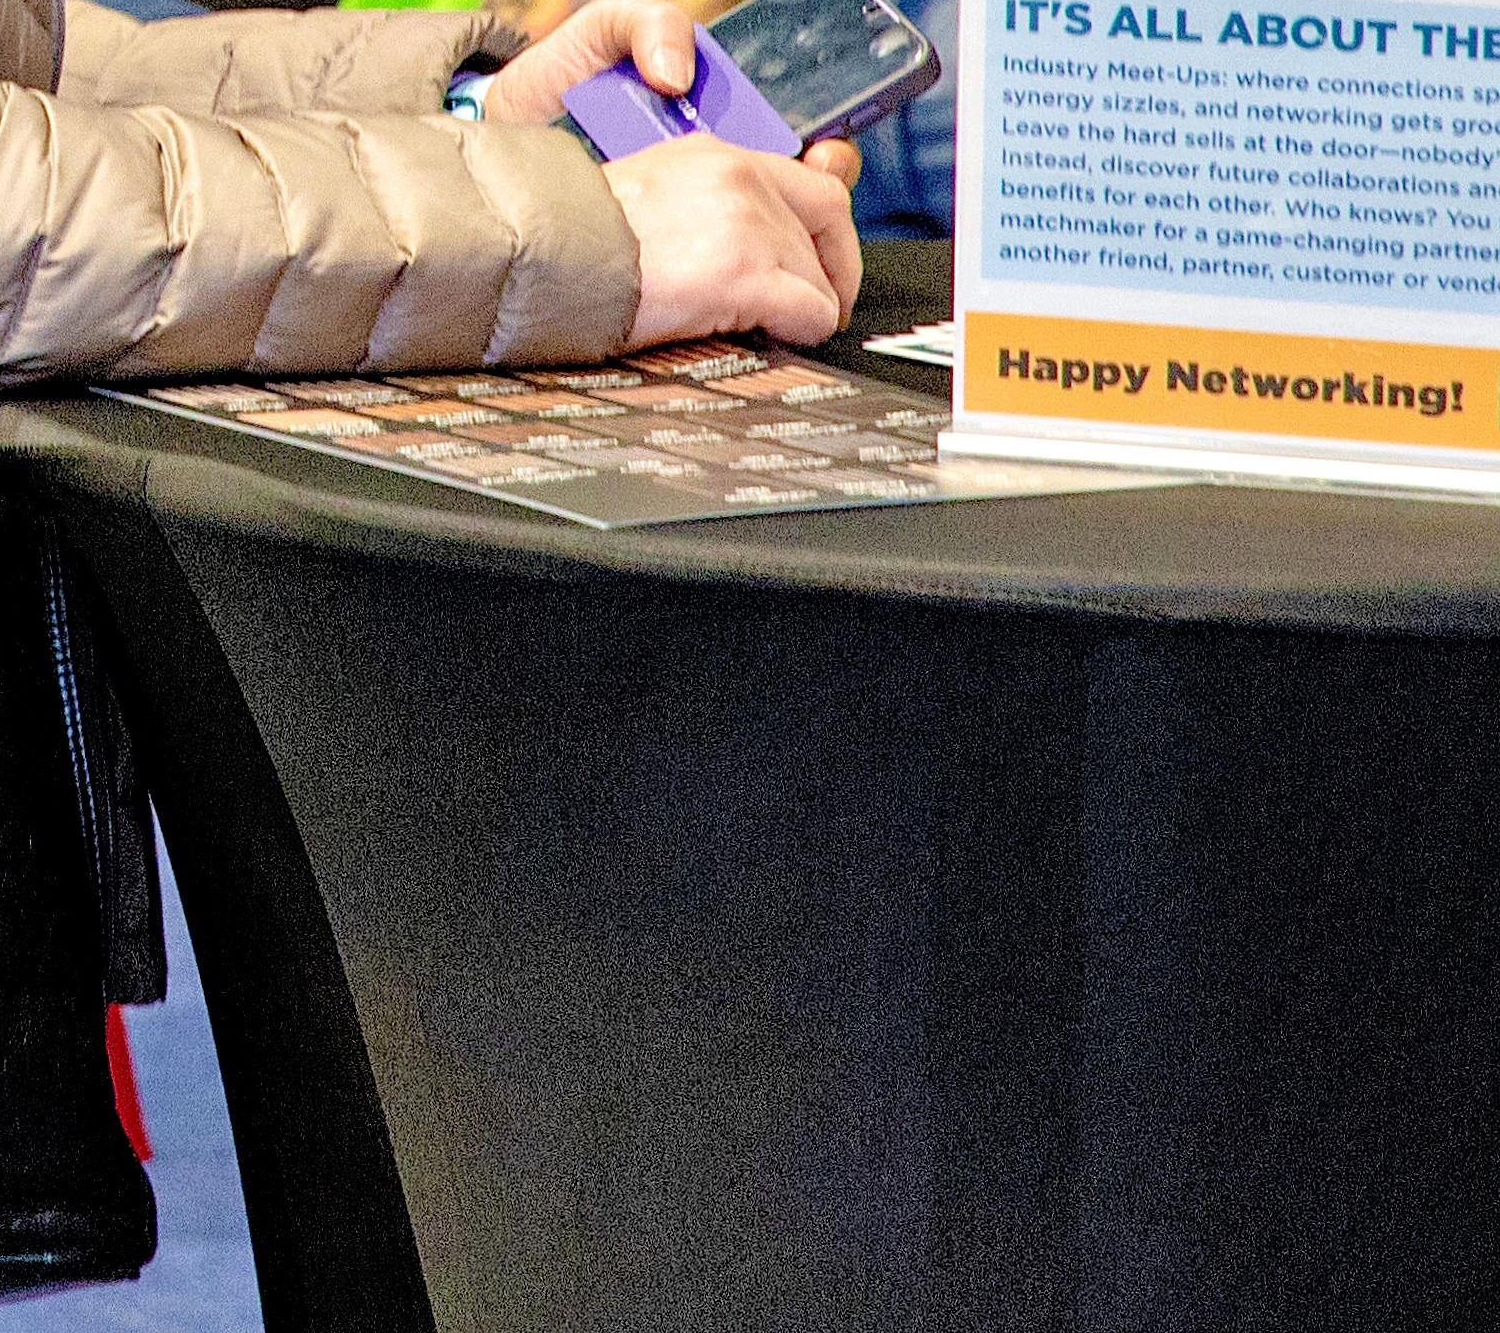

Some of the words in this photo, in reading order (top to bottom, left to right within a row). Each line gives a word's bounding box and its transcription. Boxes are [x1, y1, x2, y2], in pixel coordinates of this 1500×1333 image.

[1107, 5, 1203, 43] ALL
[1217, 11, 1397, 54] ABOUT
[1412, 21, 1500, 61] THE
[1003, 54, 1098, 81] Industry
[1107, 60, 1228, 90] Meet-Ups:
[1236, 70, 1309, 91] where
[1317, 76, 1465, 102] connections
[1002, 88, 1094, 112] synergy
[1102, 93, 1186, 118] sizzles,
[1194, 100, 1239, 118] and
[1247, 102, 1383, 131] networking
[1391, 112, 1443, 132] gets
[1002, 116, 1070, 139] Leave
[1078, 122, 1115, 142] the
[1123, 124, 1176, 147] hard
[1185, 130, 1235, 151] sells
[1243, 135, 1266, 152] at
[1275, 135, 1313, 155] the
[1002, 147, 1093, 174] Instead,
[1101, 155, 1200, 179] discover
[1209, 161, 1279, 184] future
[1288, 168, 1460, 197] collaborations
[1468, 183, 1500, 199] an
[1000, 178, 1095, 204] benefits
[1104, 185, 1137, 205] for
[1144, 190, 1200, 211] each
[1208, 195, 1276, 217] other.
[1285, 197, 1341, 220] Who
[1349, 202, 1438, 227] knows?
[1447, 208, 1491, 231] You
[1000, 211, 1145, 237] matchmaker
[1154, 219, 1187, 240] for
[1195, 227, 1207, 242] a
[1216, 227, 1404, 259] game-changing
[1000, 242, 1091, 265] another
[1100, 247, 1174, 273] friend,
[1182, 255, 1274, 282] partner,
[1282, 264, 1395, 287] customer
[1403, 272, 1428, 289] or
[1438, 274, 1500, 294] vend
[998, 347, 1150, 395] Happy
[1166, 358, 1464, 418] Networking!
